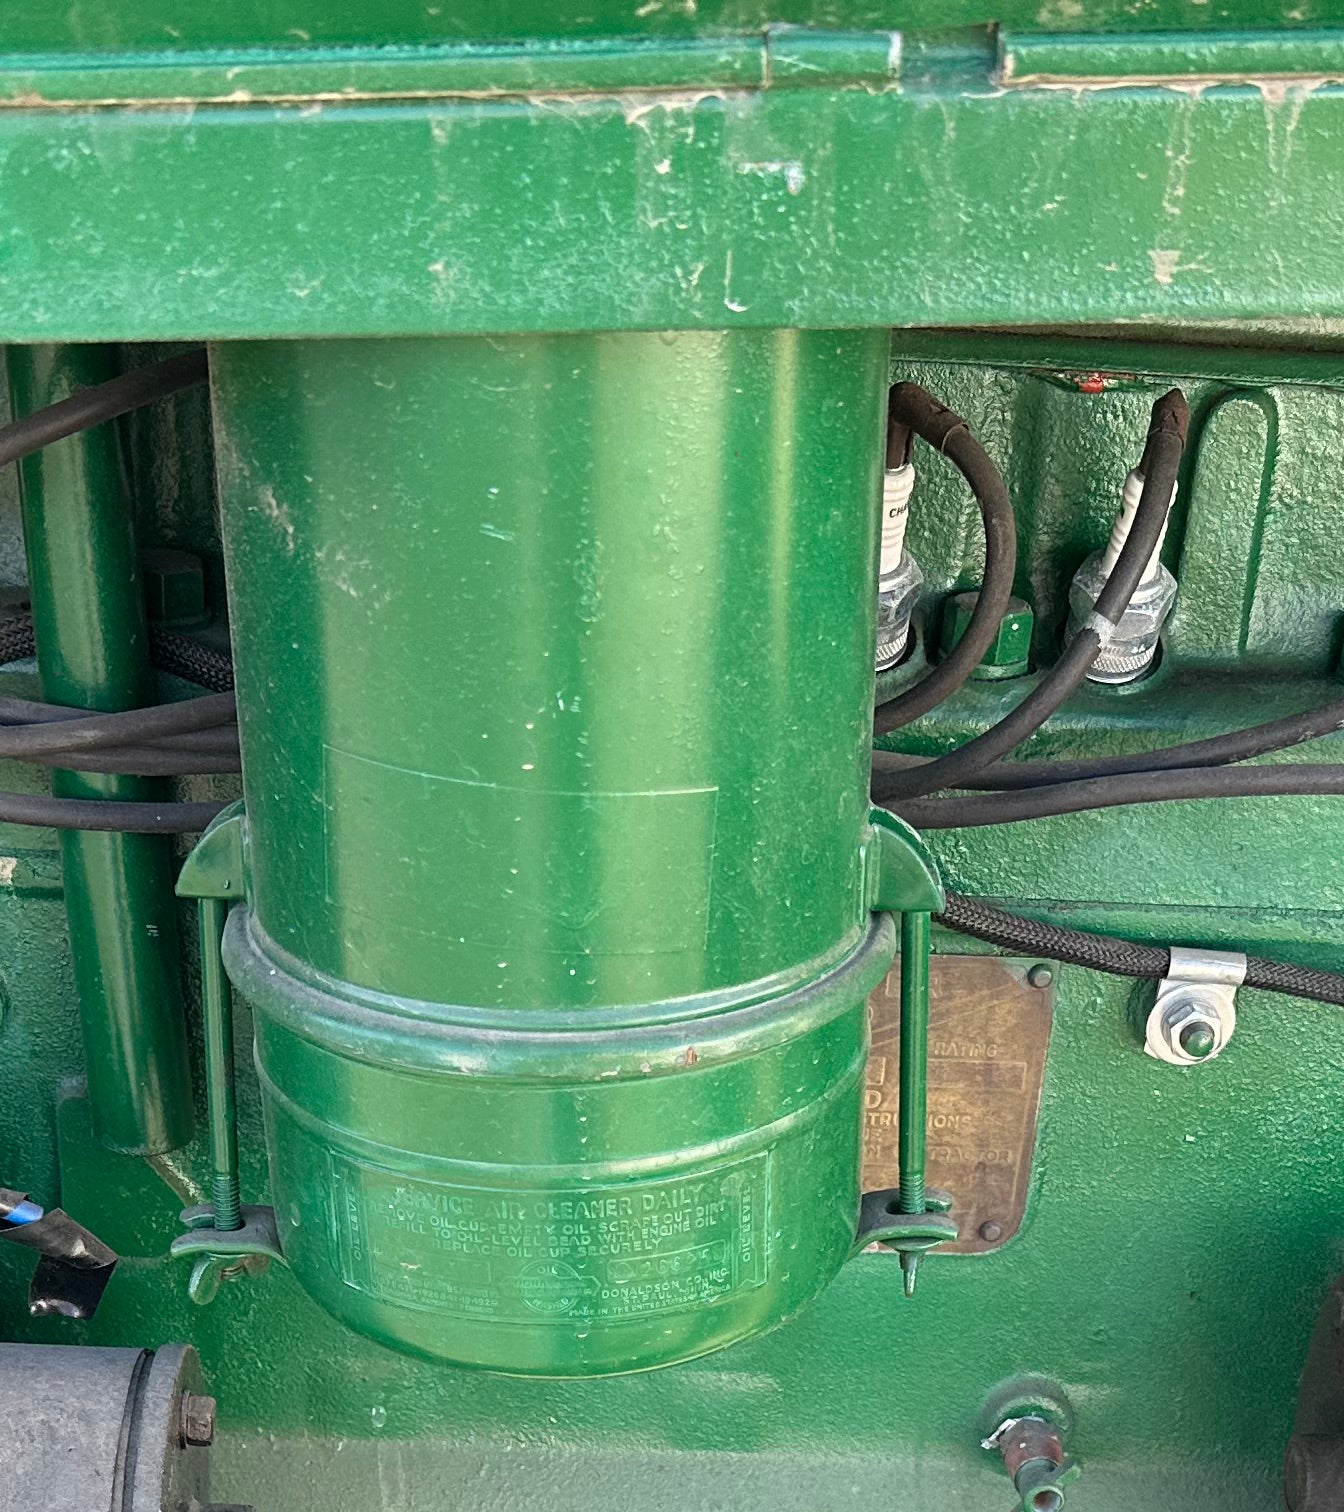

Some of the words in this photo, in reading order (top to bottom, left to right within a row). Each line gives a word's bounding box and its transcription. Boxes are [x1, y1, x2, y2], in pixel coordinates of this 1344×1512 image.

[430, 1215, 455, 1228] OIL
[663, 1207, 692, 1224] OUT
[696, 1200, 725, 1218] DIRT
[485, 1200, 524, 1220] AIR
[534, 1196, 632, 1220] CLEANER
[642, 1183, 705, 1211] DAILY
[432, 1226, 451, 1240] TO
[597, 1231, 635, 1245] WITH
[641, 1221, 690, 1239] ENGINE
[695, 1216, 717, 1229] OIL
[432, 1238, 502, 1257] REPLACE
[506, 1247, 533, 1258] OIL
[541, 1247, 571, 1258] CUP
[578, 1237, 663, 1257] SECURELY
[601, 1280, 680, 1300] DONALDSON
